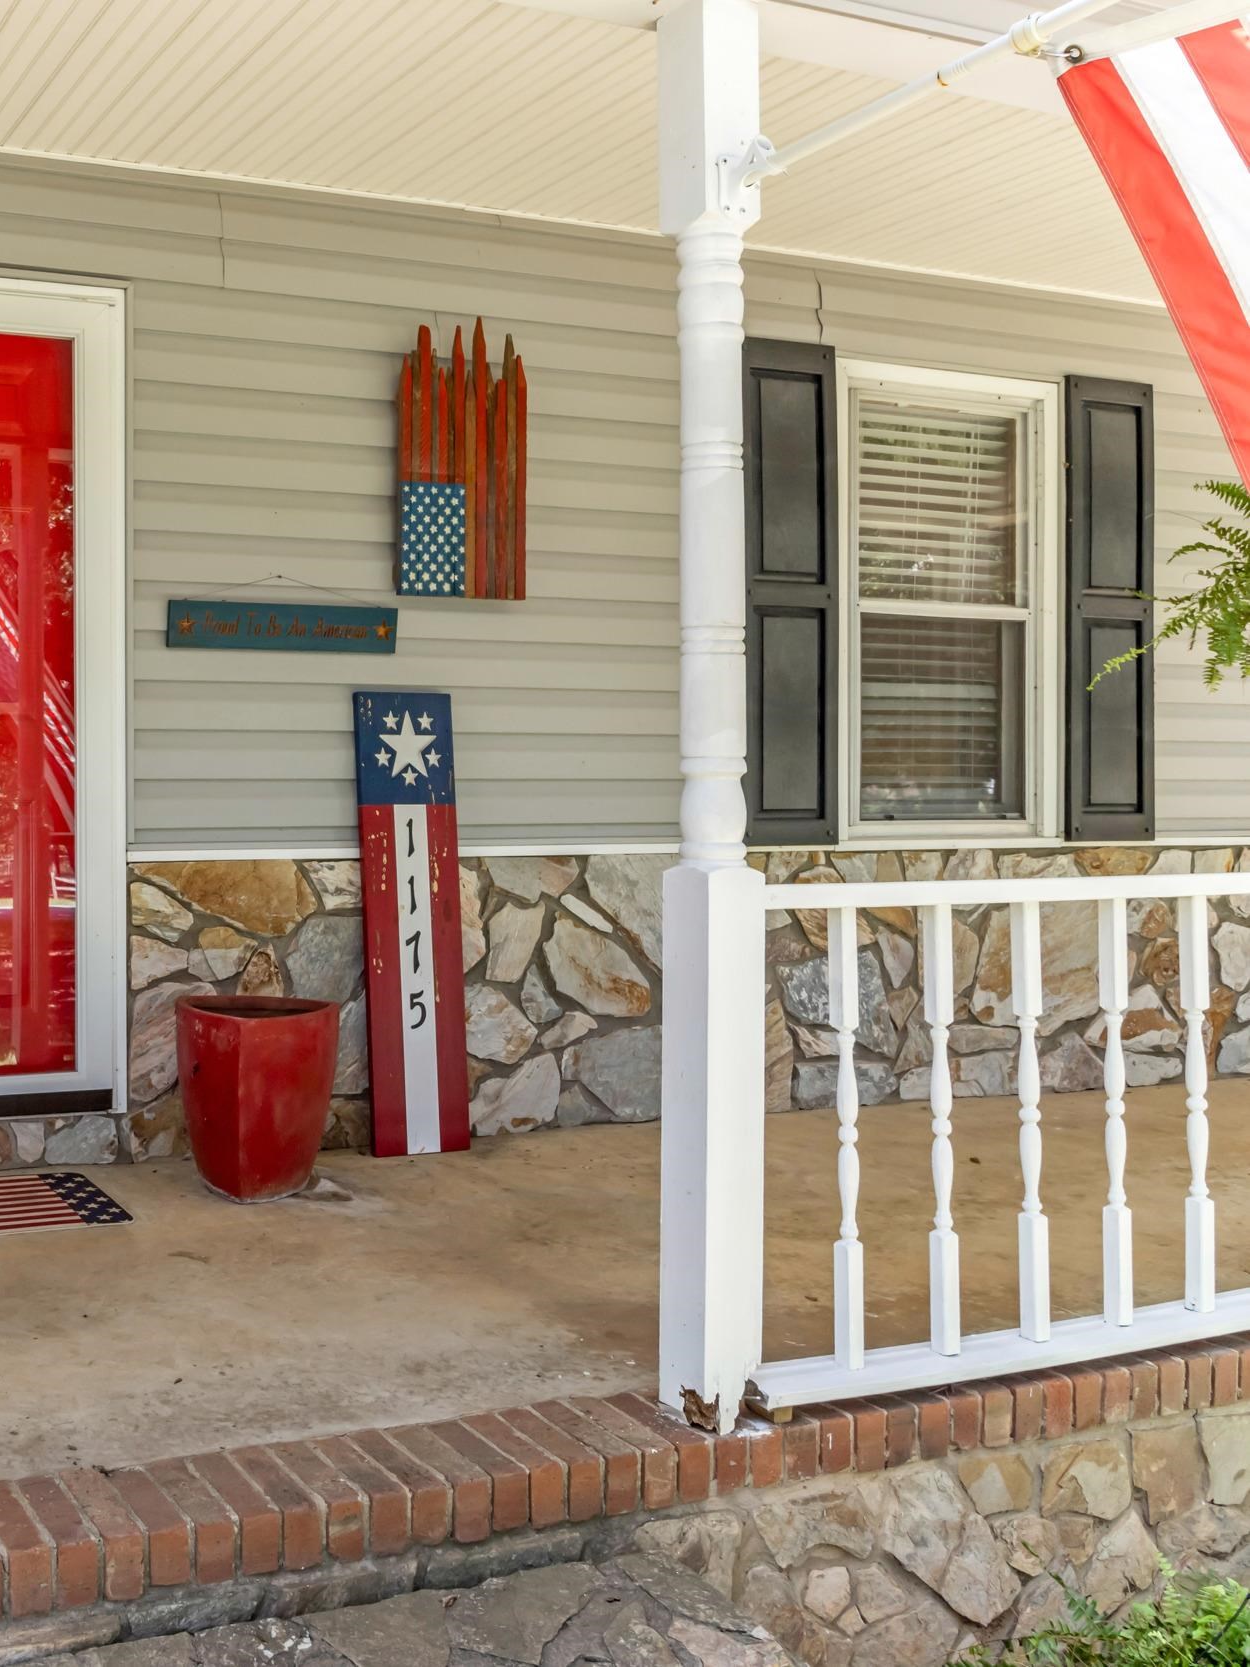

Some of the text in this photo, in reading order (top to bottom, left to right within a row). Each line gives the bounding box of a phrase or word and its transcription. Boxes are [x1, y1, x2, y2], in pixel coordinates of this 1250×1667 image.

[246, 611, 262, 636] To
[286, 614, 306, 637] An
[405, 817, 427, 1030] 1175
